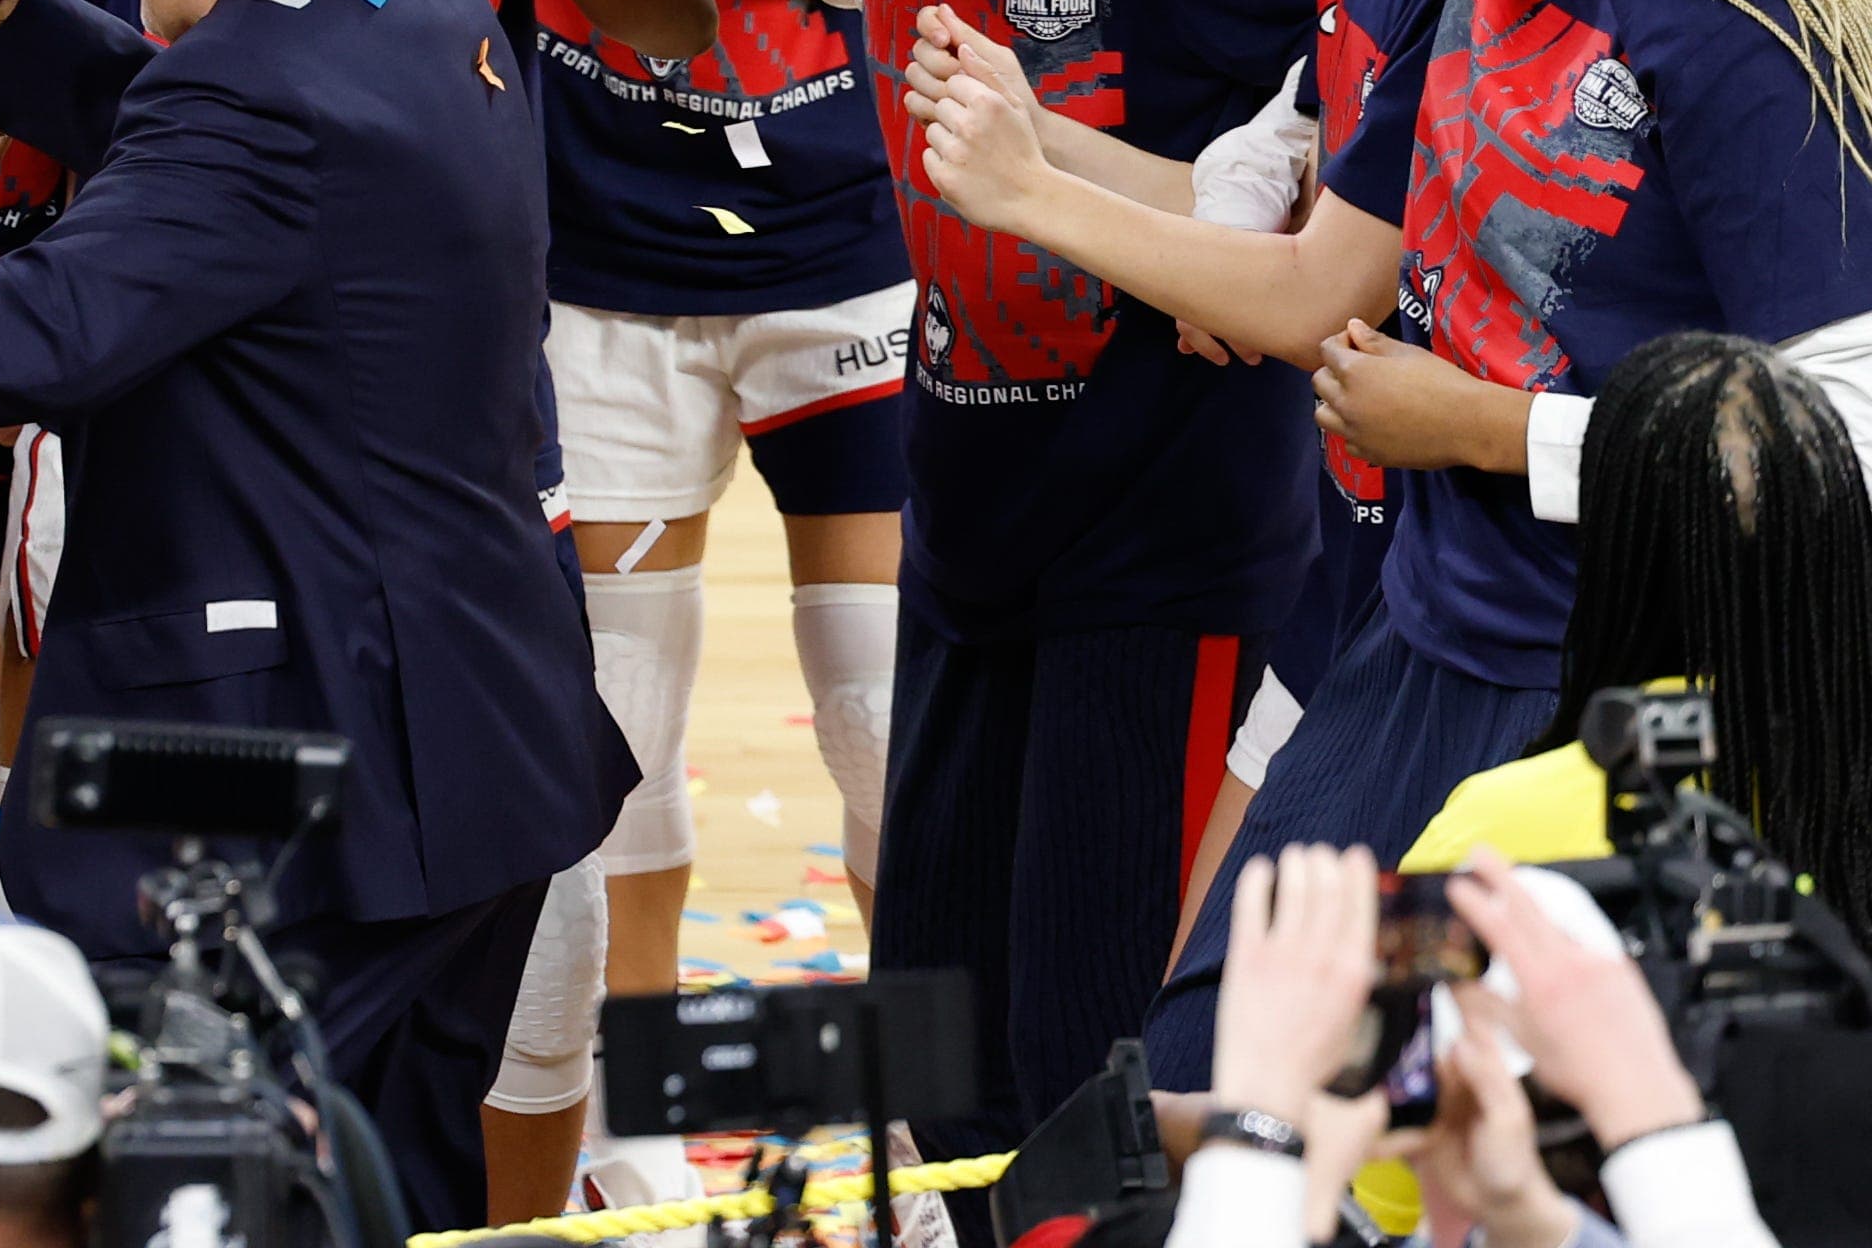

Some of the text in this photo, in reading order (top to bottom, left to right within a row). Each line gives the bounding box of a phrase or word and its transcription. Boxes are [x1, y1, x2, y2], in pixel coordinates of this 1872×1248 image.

[662, 87, 766, 121] REGIONAL
[770, 69, 856, 115] CHAMPS
[1600, 85, 1642, 122] FOUR
[935, 379, 1040, 406] REGIONAL
